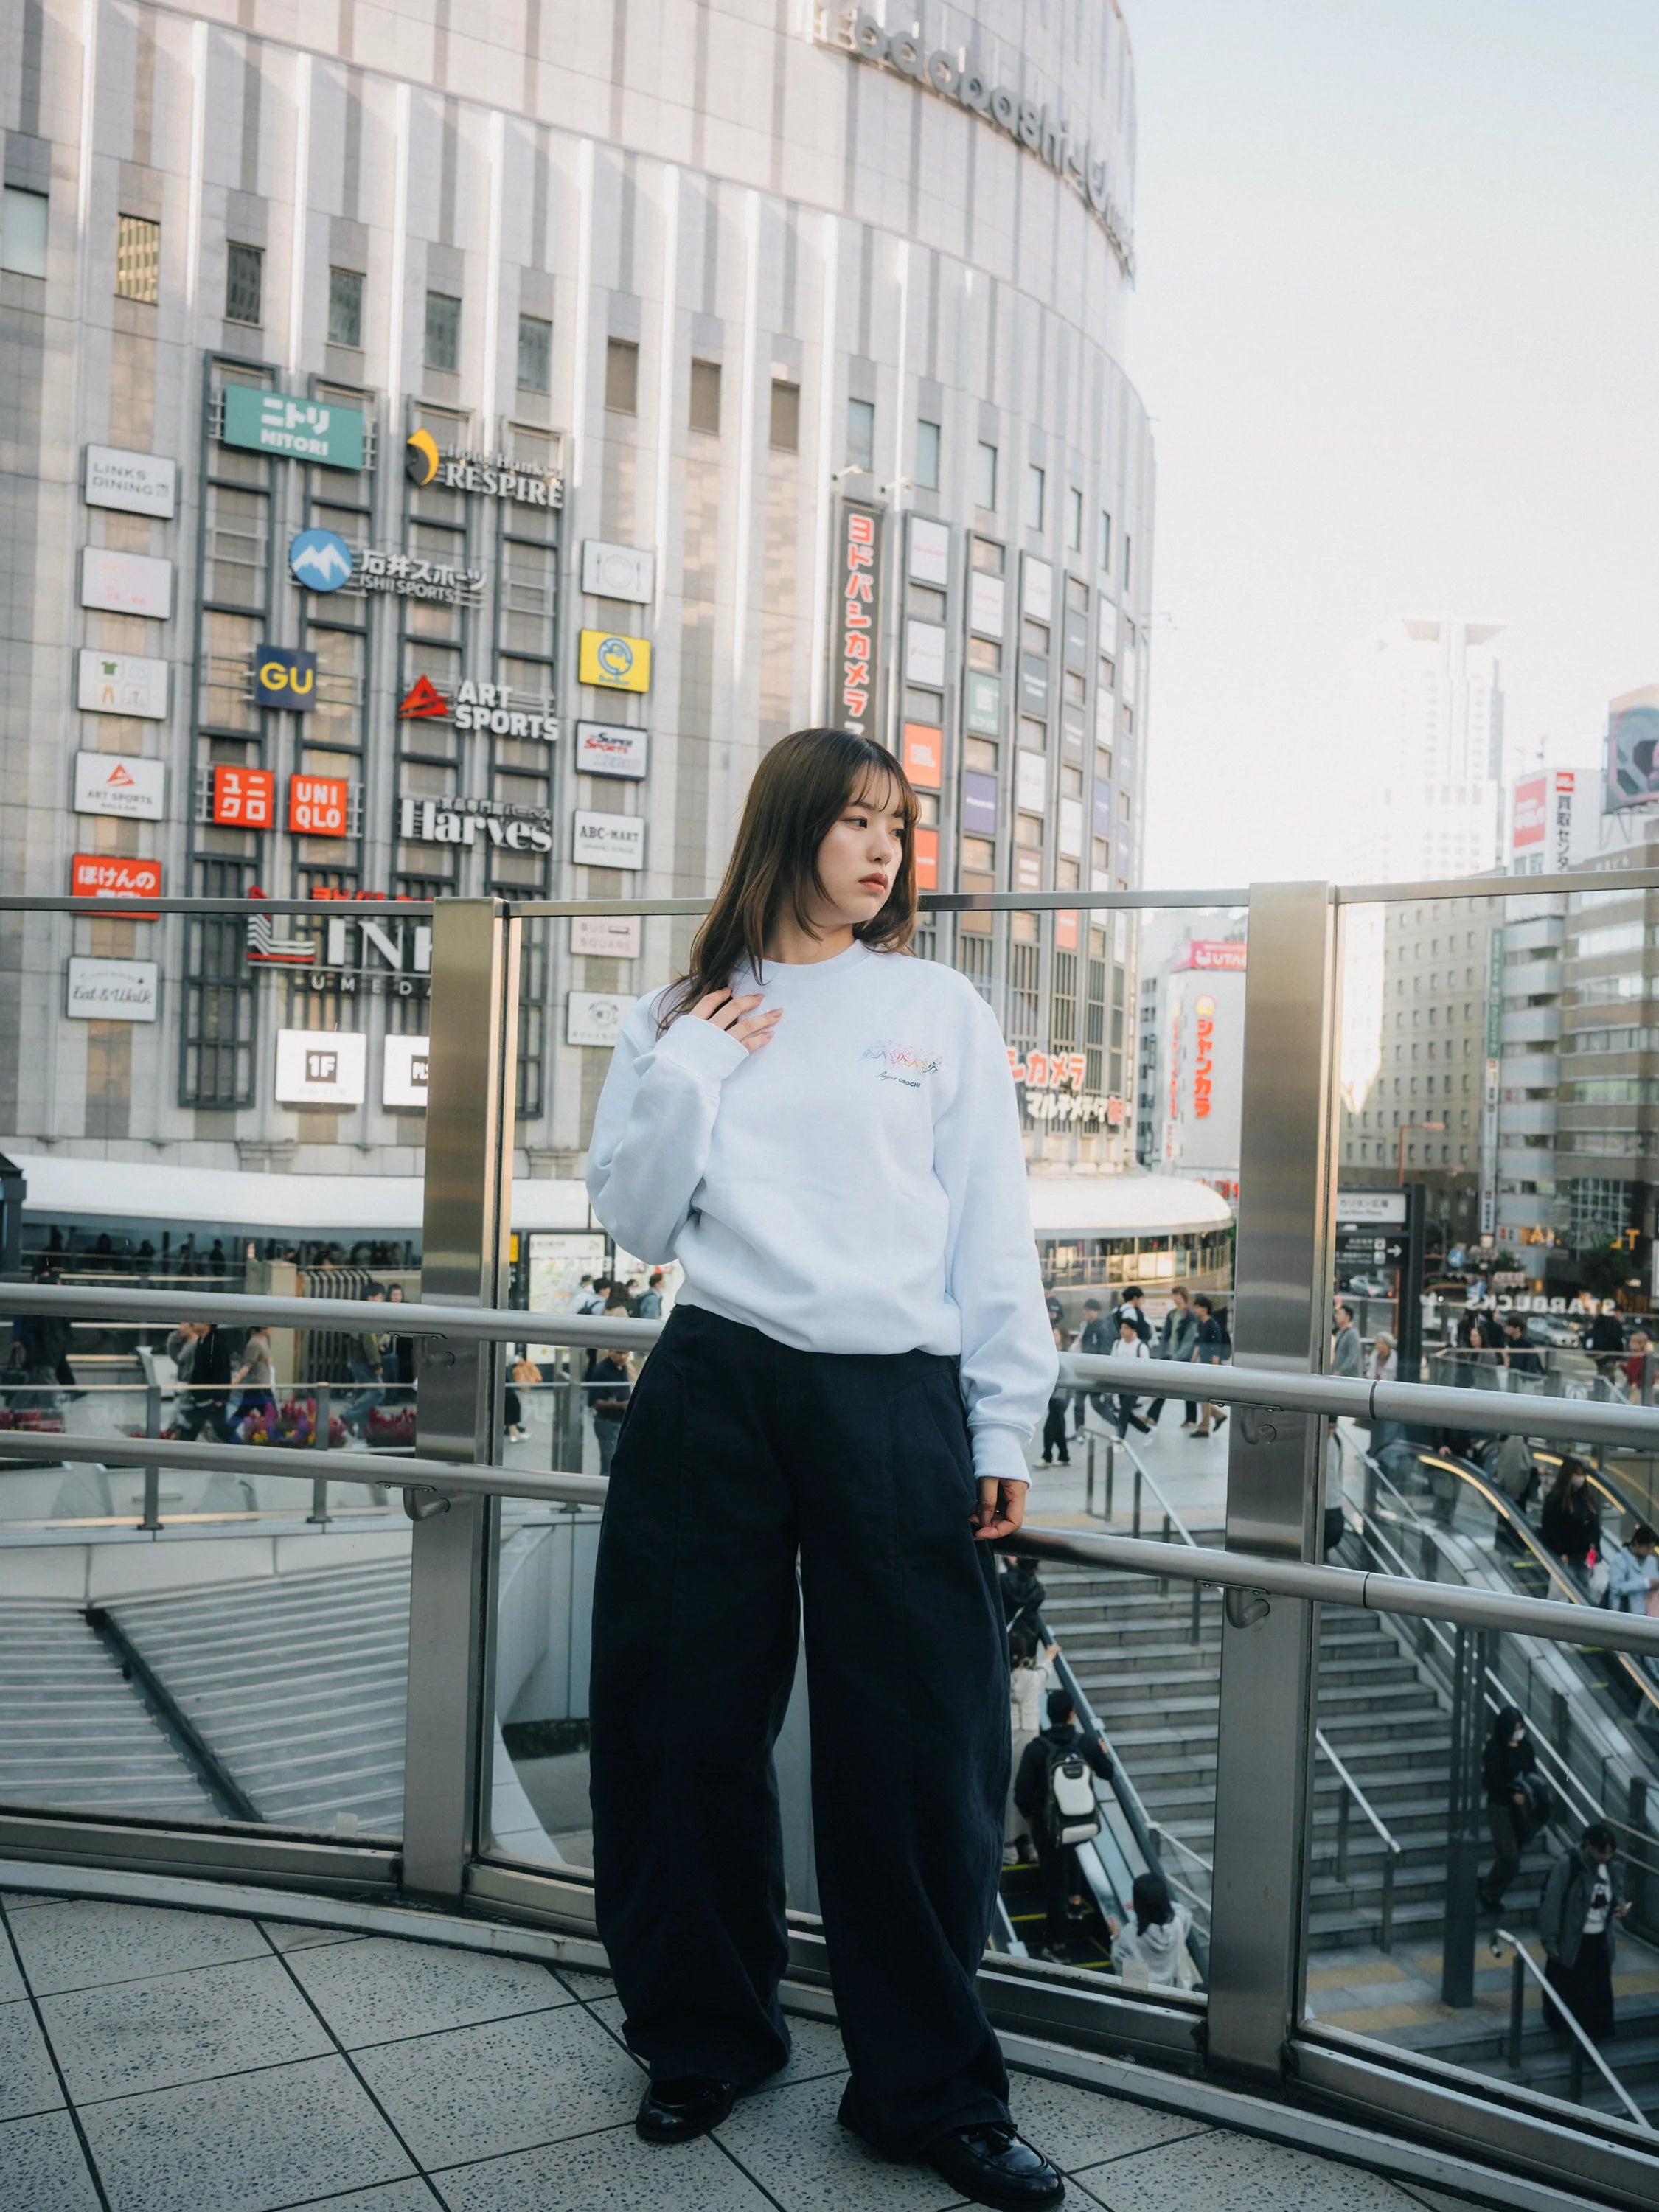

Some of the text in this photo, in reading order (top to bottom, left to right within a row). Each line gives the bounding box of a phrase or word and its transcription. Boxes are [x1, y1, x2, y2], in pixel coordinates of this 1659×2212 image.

[261, 397, 330, 436] ニトリ
[260, 428, 329, 456] NITORI
[94, 462, 146, 481] LINKS
[445, 462, 563, 509] RESPIRE
[92, 476, 153, 496] DINING
[361, 549, 487, 591] 石井スポーツ
[360, 572, 456, 604] ISHII SPORTS
[844, 513, 875, 717] ヨドバシカメラ
[260, 661, 313, 695] GU
[457, 679, 514, 709] ART
[454, 704, 560, 741] SPORTS
[296, 782, 338, 805] UNI
[296, 806, 341, 830] QLO
[400, 799, 553, 852] Harves
[580, 825, 639, 841] ABC-MART
[77, 865, 156, 890] ほけんの
[310, 975, 431, 997] UMED
[308, 1055, 336, 1078] 1F
[898, 1078, 921, 1088] OROCHI
